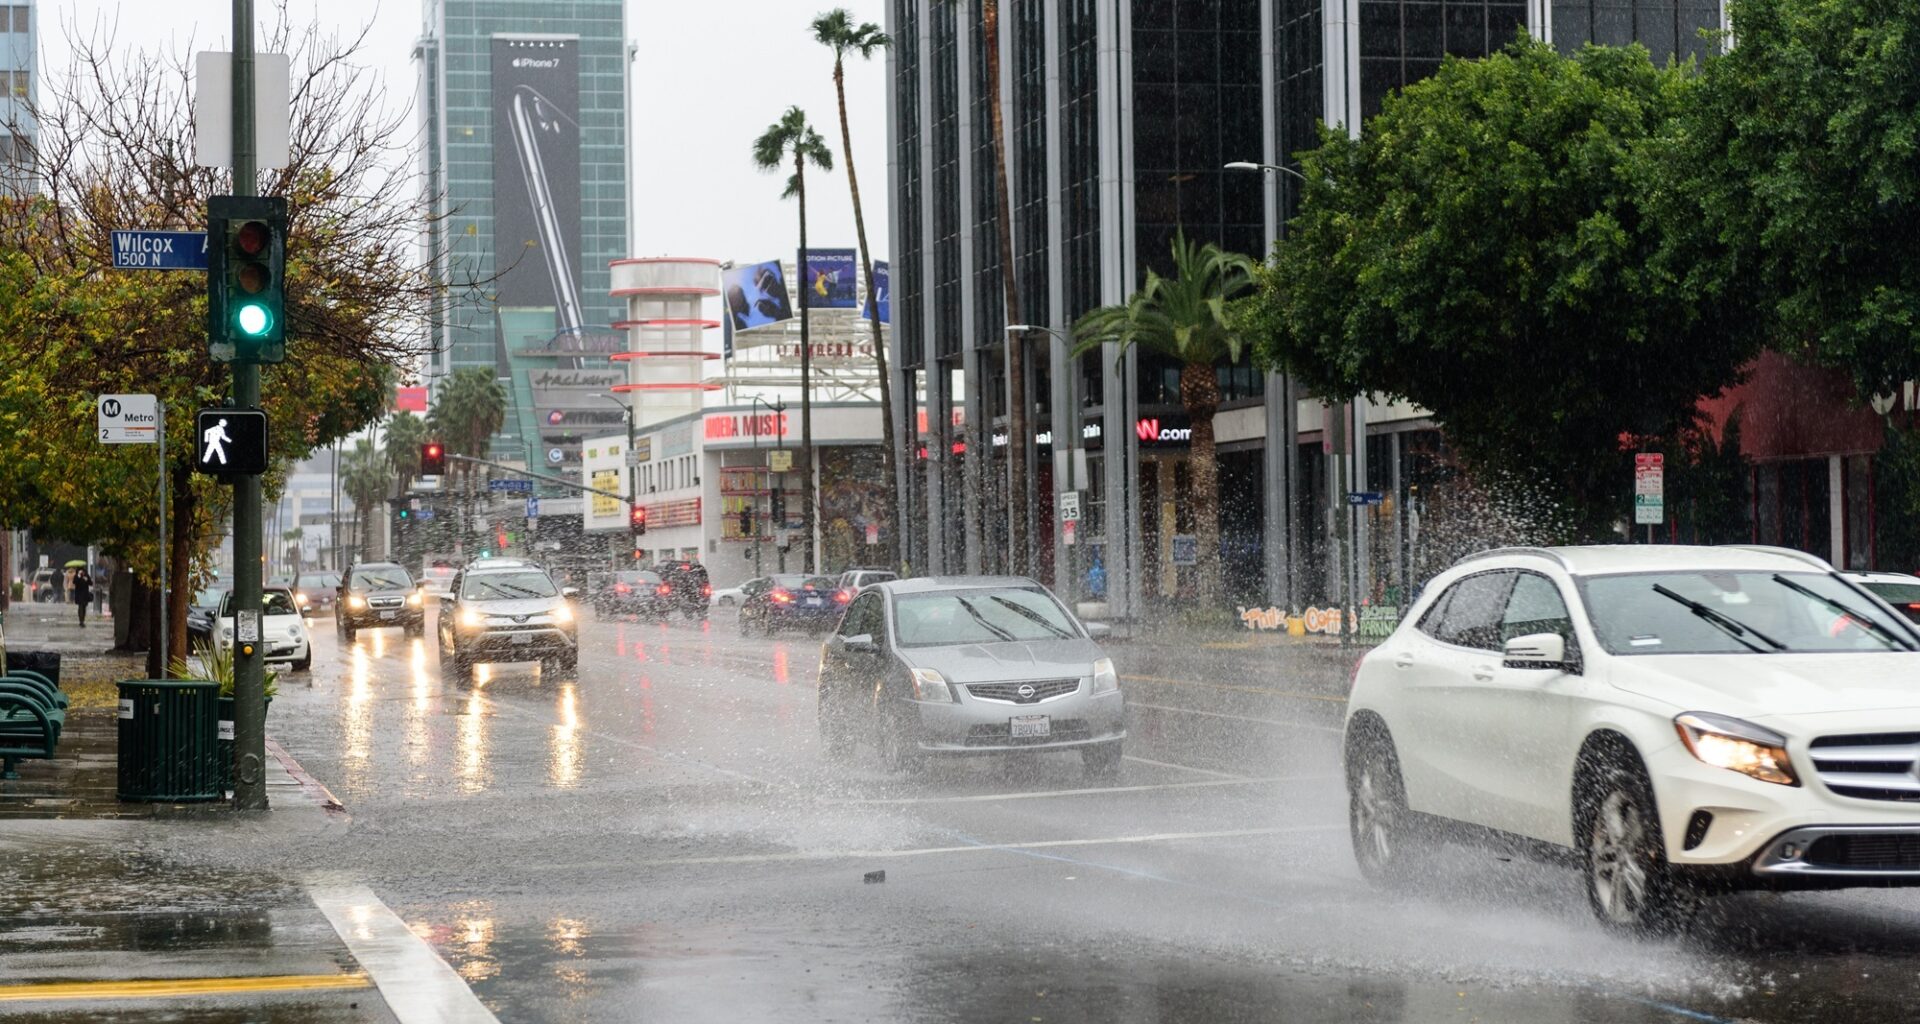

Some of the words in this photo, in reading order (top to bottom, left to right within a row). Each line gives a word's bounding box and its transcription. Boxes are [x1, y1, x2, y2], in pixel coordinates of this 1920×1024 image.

[520, 58, 552, 68] iPhone
[553, 58, 560, 68] 7
[117, 233, 173, 253] Wilcox
[118, 252, 146, 266] 1500
[152, 253, 160, 266] N
[105, 402, 118, 415] M
[124, 414, 154, 422] Metro
[705, 416, 739, 438] AMOEBA
[742, 414, 787, 436] MUSIC
[102, 429, 109, 439] 2
[1063, 507, 1078, 518] 35
